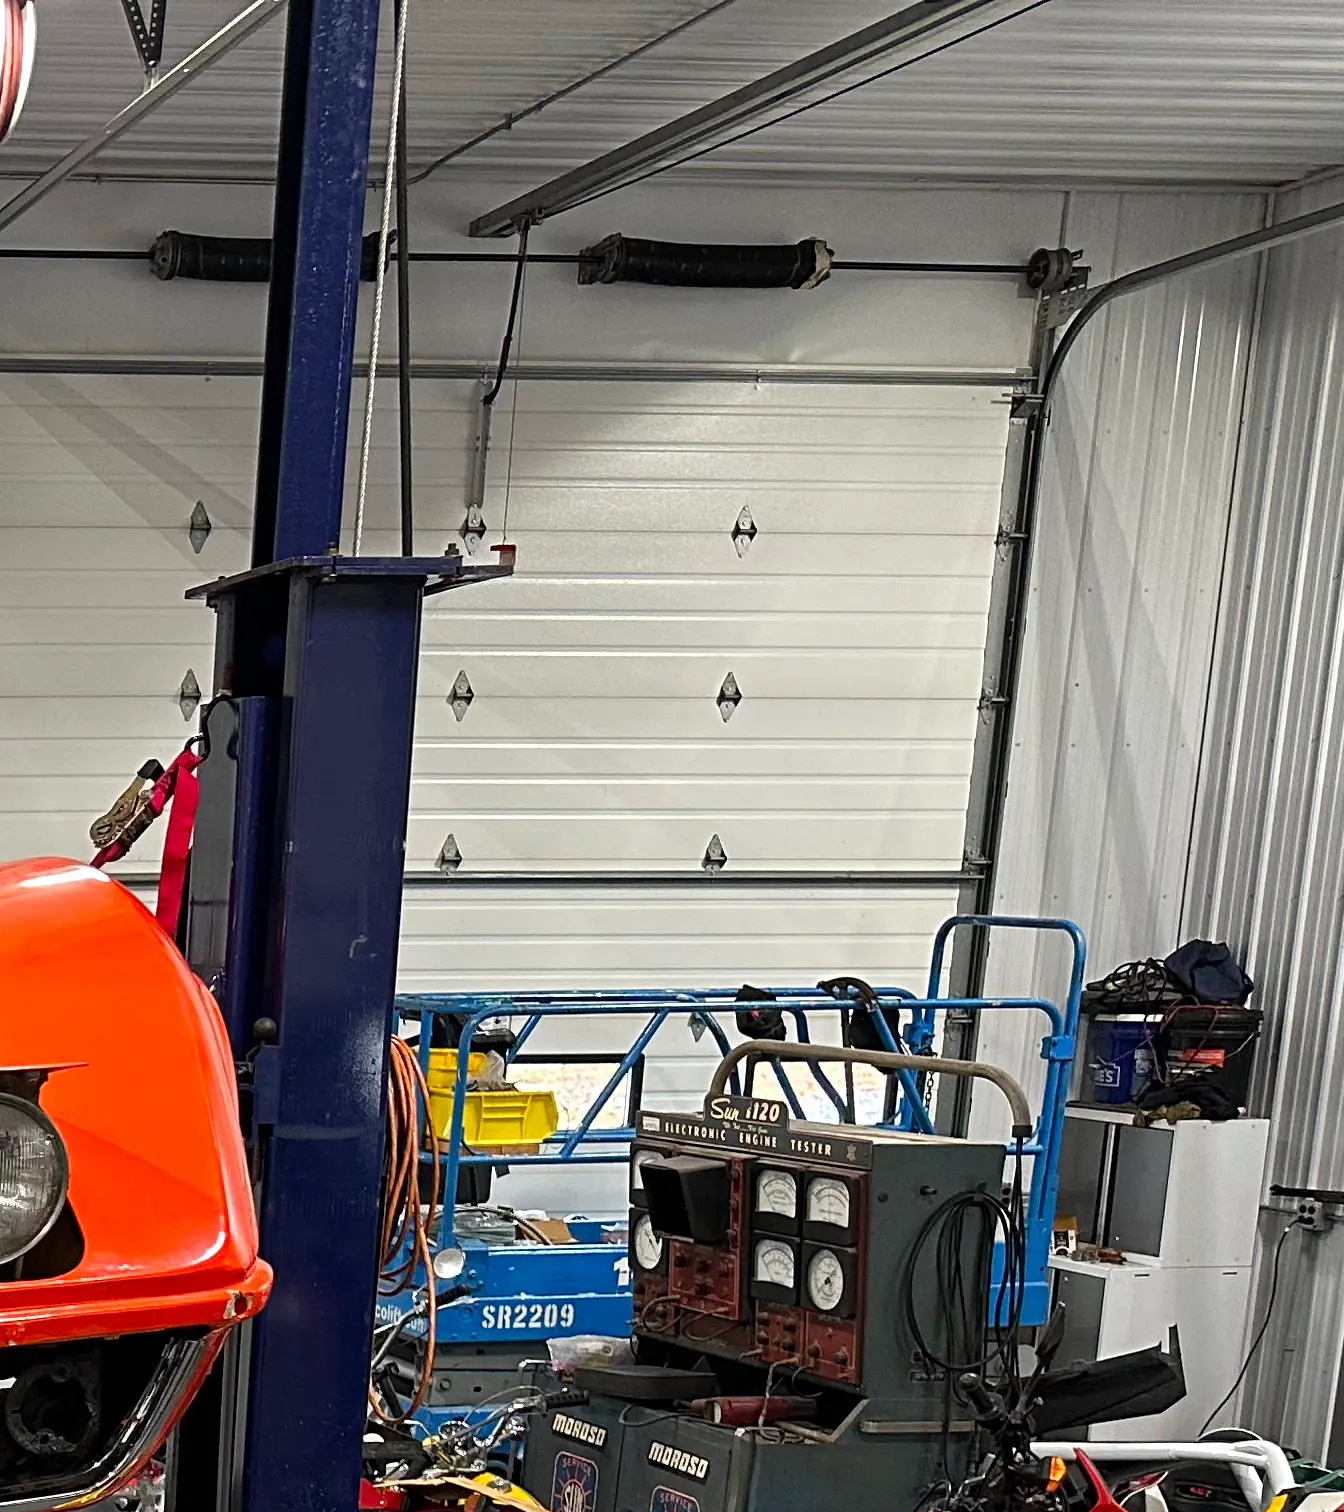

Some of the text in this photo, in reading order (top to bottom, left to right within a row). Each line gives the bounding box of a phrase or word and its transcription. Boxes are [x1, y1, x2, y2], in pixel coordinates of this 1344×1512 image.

[710, 1097, 739, 1121] Sun
[665, 1121, 726, 1141] ELECTRONIC
[739, 1129, 778, 1149] ENGINE
[790, 1138, 832, 1156] TESTER
[481, 1303, 574, 1329] SR2209
[552, 1413, 607, 1447] MOROSO
[562, 1457, 593, 1477] SERVICE
[648, 1441, 709, 1479] MOROSO
[660, 1491, 693, 1512] SERVICE
